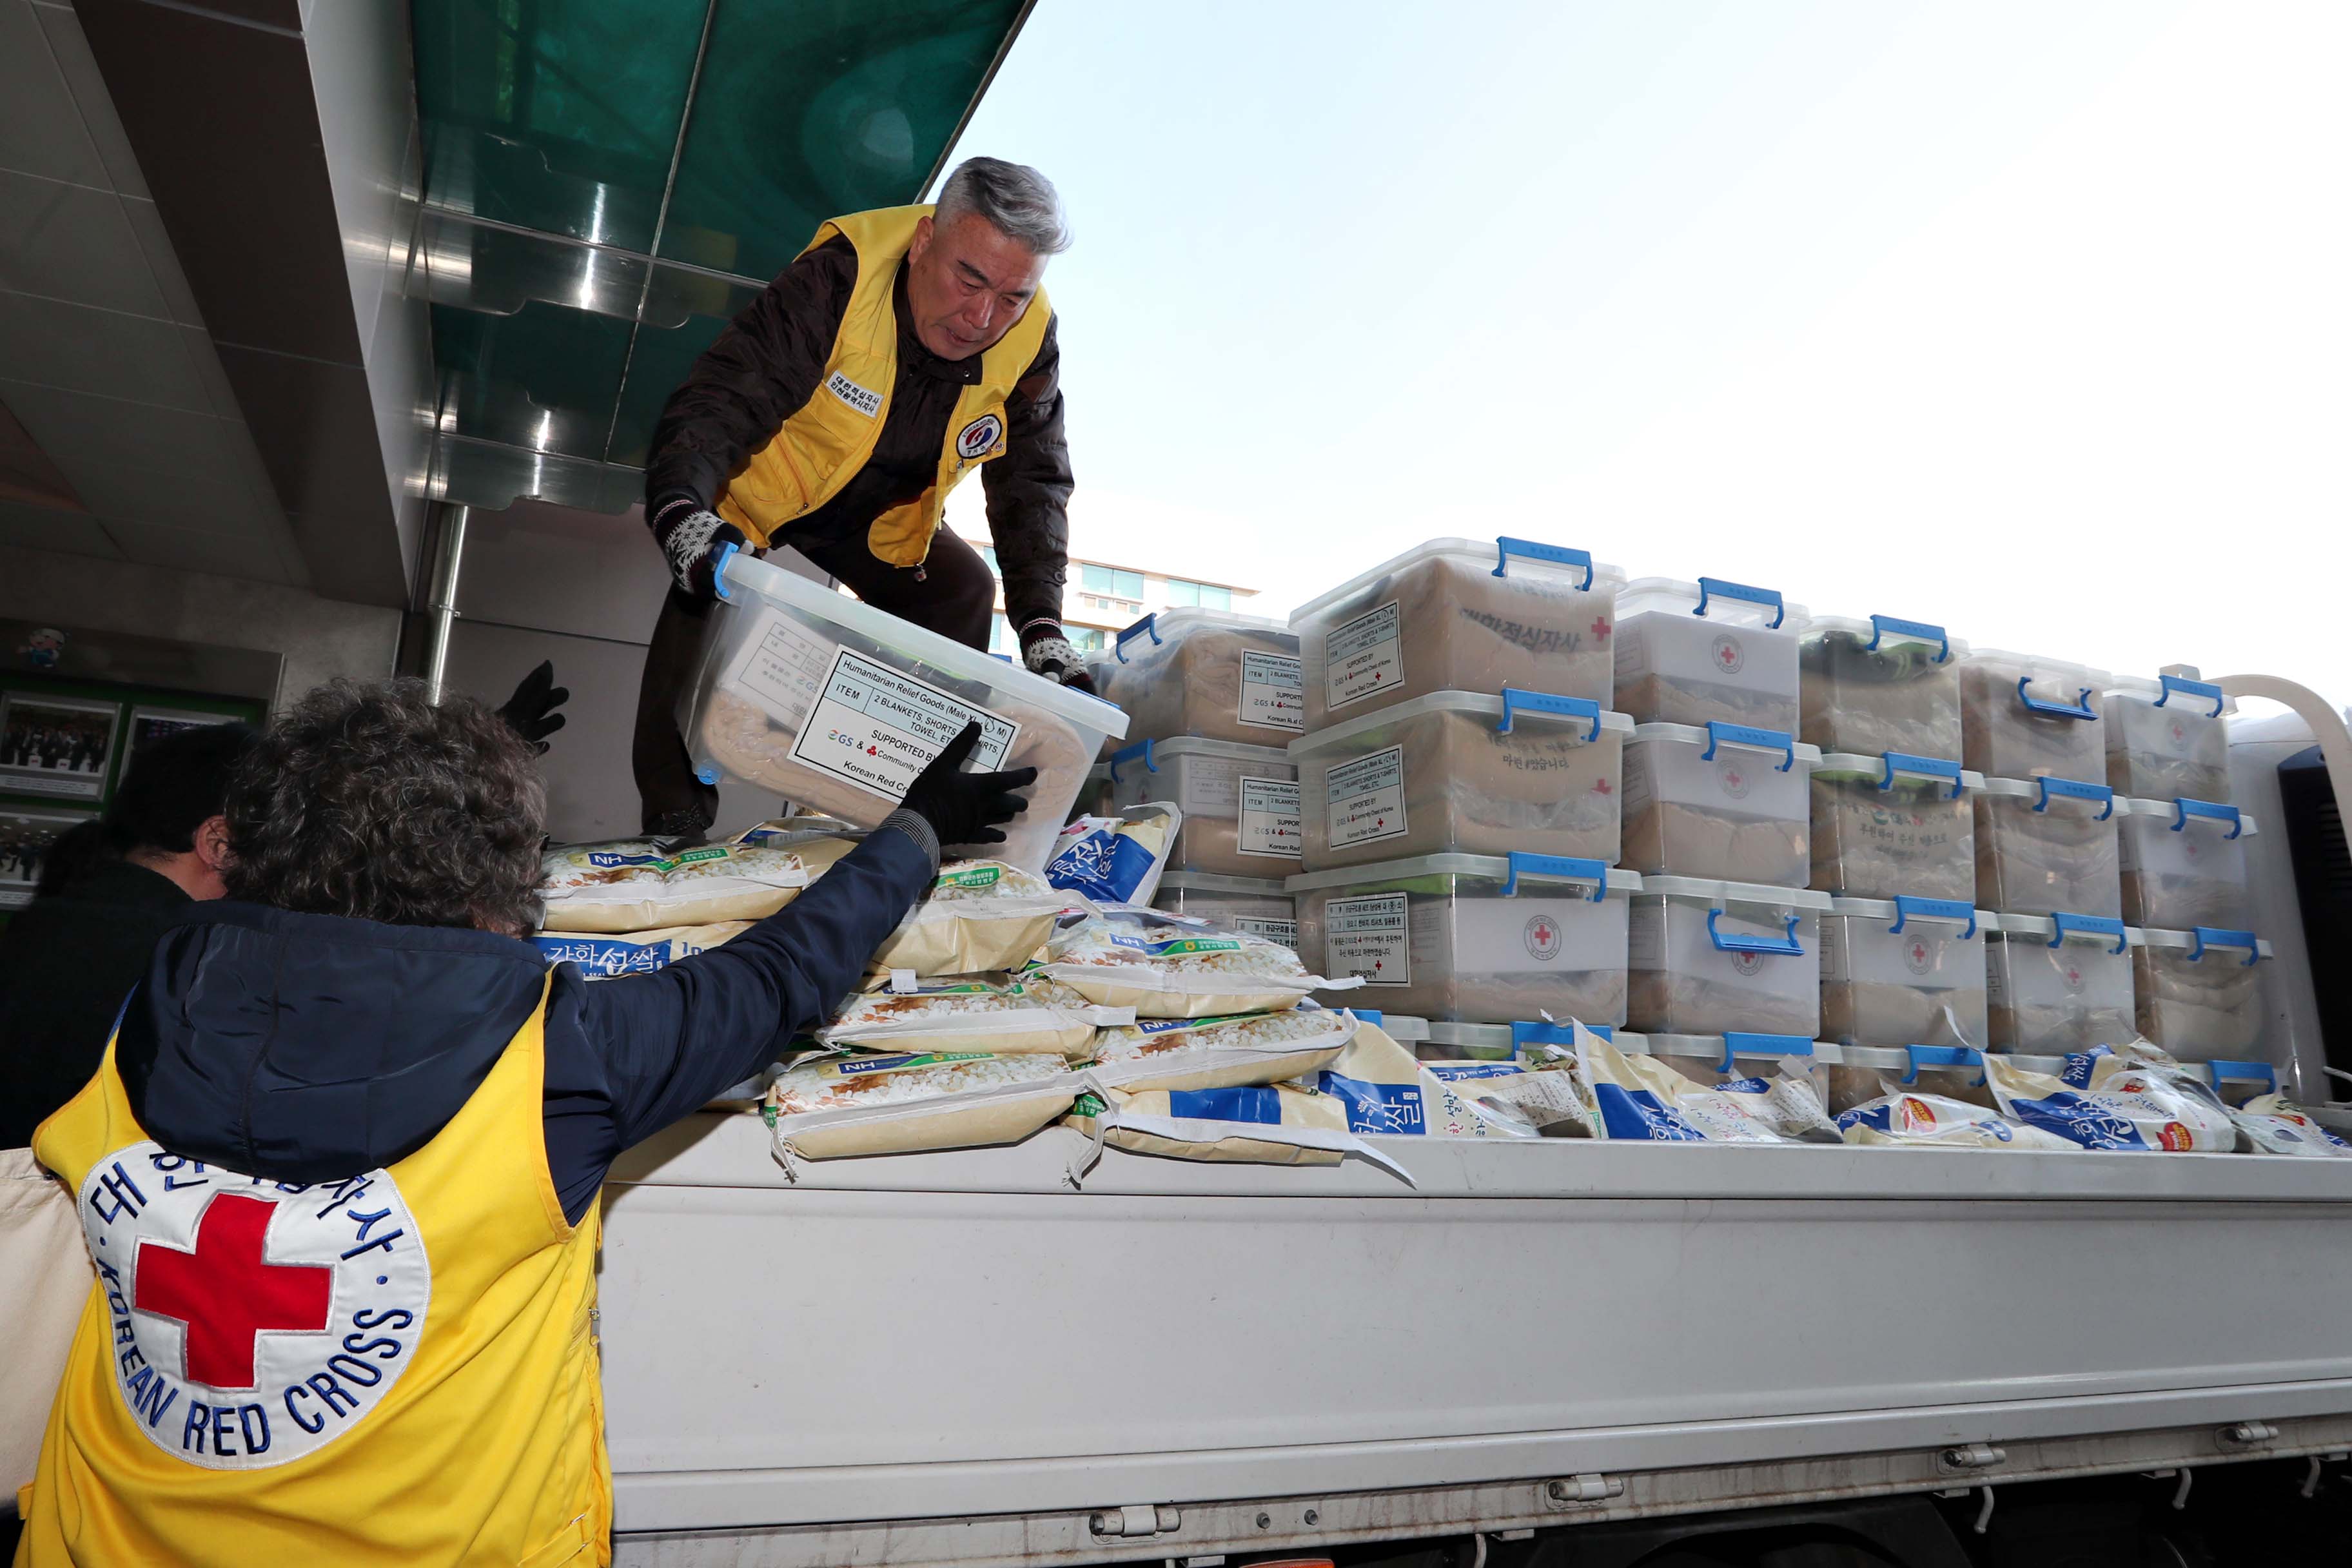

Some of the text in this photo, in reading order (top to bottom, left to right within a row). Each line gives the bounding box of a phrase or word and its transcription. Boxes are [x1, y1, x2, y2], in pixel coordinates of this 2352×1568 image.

[830, 381, 876, 413] 인천광역시지사
[836, 375, 879, 405] 대한적십자사
[836, 683, 861, 700] ITEM
[843, 660, 896, 689] Humanitarian
[896, 683, 920, 699] Relief
[919, 693, 945, 711] Goods
[945, 705, 967, 720] (Male
[874, 695, 880, 703] 2
[880, 697, 923, 723] BLANKETS,
[925, 717, 957, 736] SHORTS
[871, 729, 925, 759] SUPPORTED
[910, 721, 939, 741] TOWEL,
[856, 741, 864, 750] &
[877, 750, 917, 773] Community
[843, 760, 876, 780] Korean
[877, 774, 896, 788] Red
[594, 855, 623, 865] NH
[1268, 843, 1289, 851] Korean
[1113, 936, 1141, 947] NH
[845, 1061, 876, 1072] NH
[1381, 1096, 1421, 1133] 쌀
[97, 1256, 414, 1456] KOREAN RED CROSS
